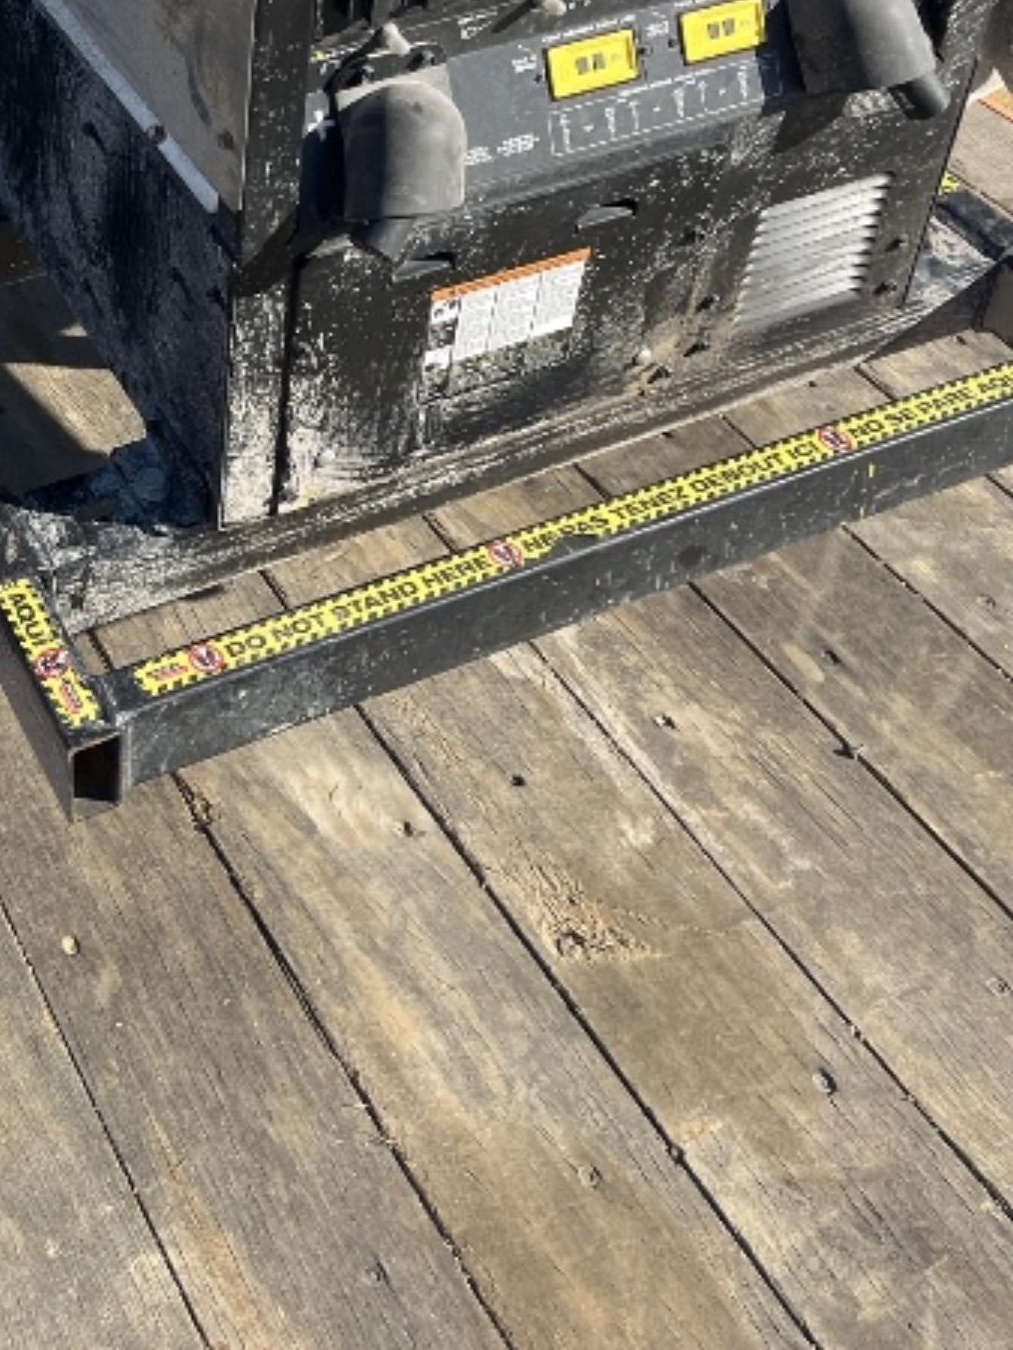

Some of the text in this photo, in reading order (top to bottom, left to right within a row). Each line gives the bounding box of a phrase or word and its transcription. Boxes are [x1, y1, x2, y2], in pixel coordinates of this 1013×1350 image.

[850, 419, 885, 436] NO
[614, 485, 689, 522] TENEZ
[689, 453, 784, 493] DEBOUT
[786, 439, 820, 461] ICI
[225, 553, 495, 658] DO NOT STAND HERE
